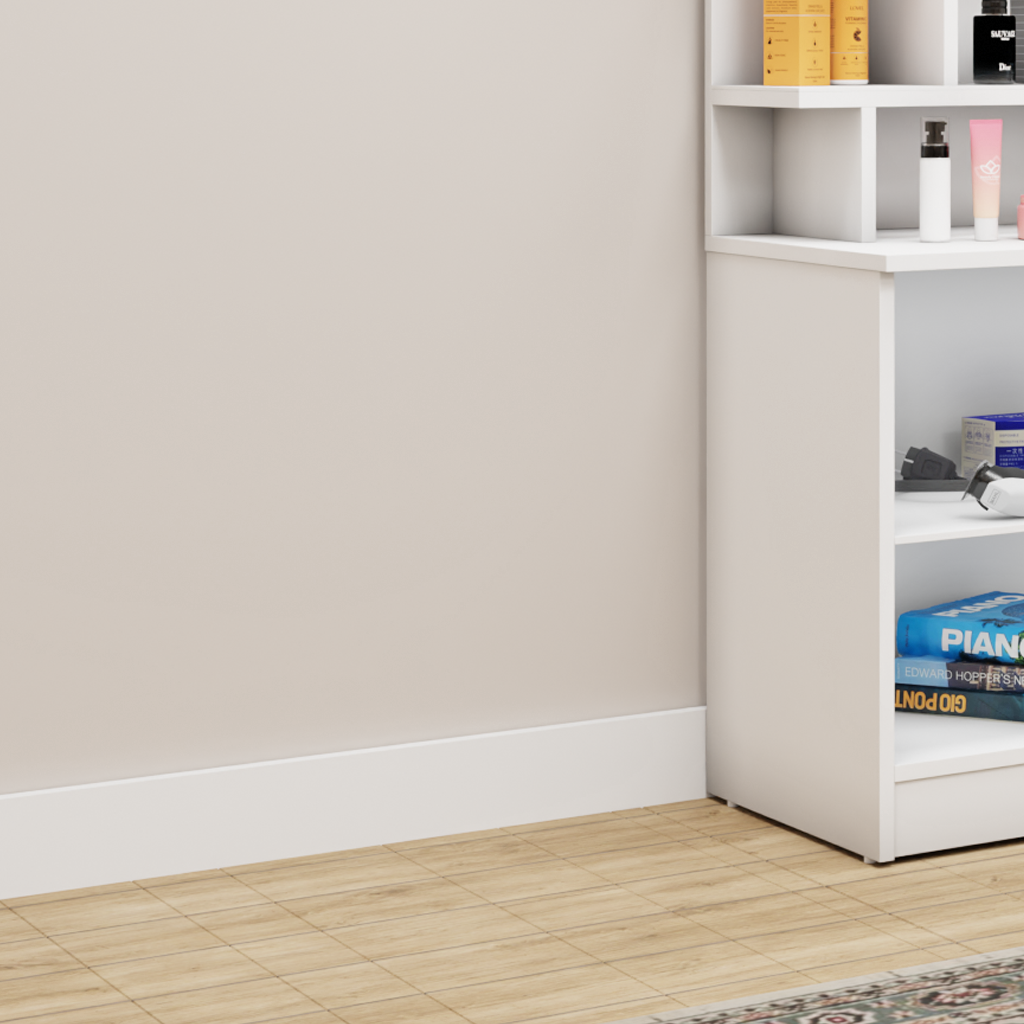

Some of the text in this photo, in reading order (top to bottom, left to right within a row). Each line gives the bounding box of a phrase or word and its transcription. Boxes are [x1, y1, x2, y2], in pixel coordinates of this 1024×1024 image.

[998, 62, 1012, 72] Dior
[905, 666, 953, 680] EDWARD
[955, 670, 1011, 685] HOPPER'S
[939, 693, 967, 714] GIO
